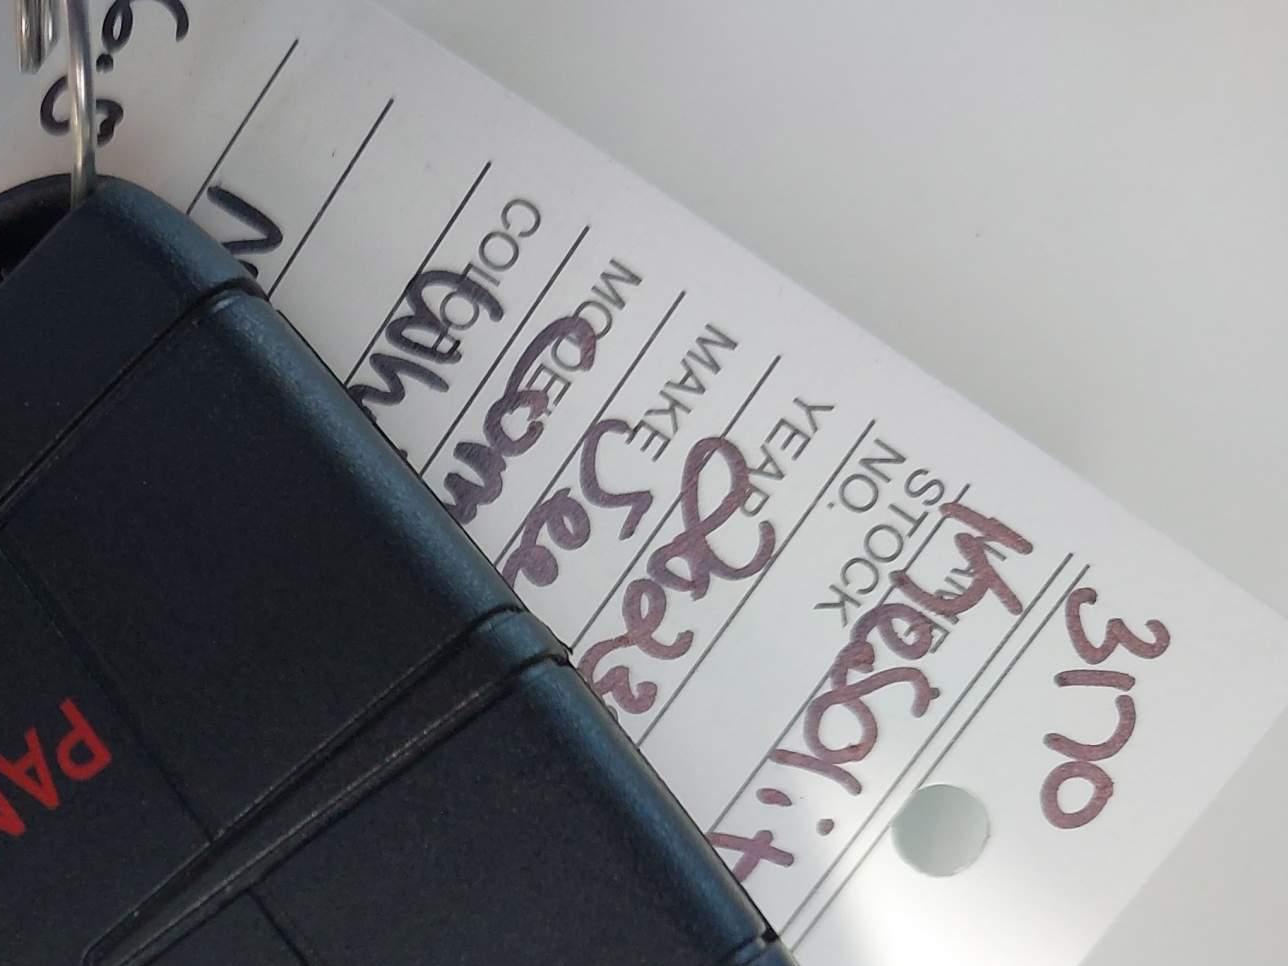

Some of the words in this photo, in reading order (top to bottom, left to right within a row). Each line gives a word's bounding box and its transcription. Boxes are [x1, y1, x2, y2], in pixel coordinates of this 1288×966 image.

[625, 322, 739, 463] MAKE
[813, 467, 944, 627] STOCK
[827, 438, 907, 513] NO.
[580, 436, 776, 715] 2023
[1040, 587, 1171, 829] 3170
